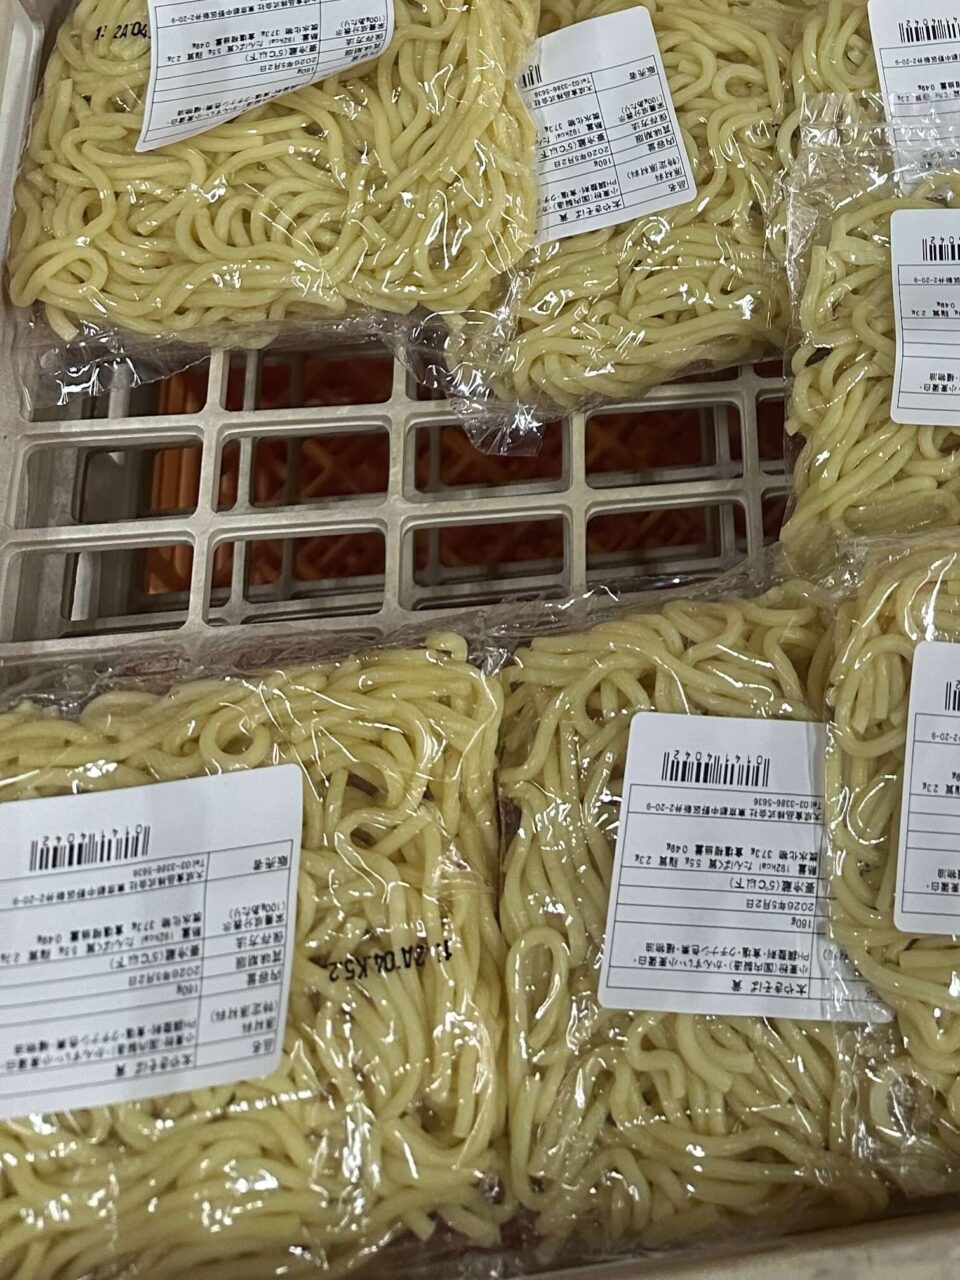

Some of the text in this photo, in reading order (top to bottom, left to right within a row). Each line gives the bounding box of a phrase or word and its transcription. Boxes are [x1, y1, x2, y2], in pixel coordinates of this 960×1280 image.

[791, 916, 811, 928] 160g
[751, 980, 807, 994] 太やきそば
